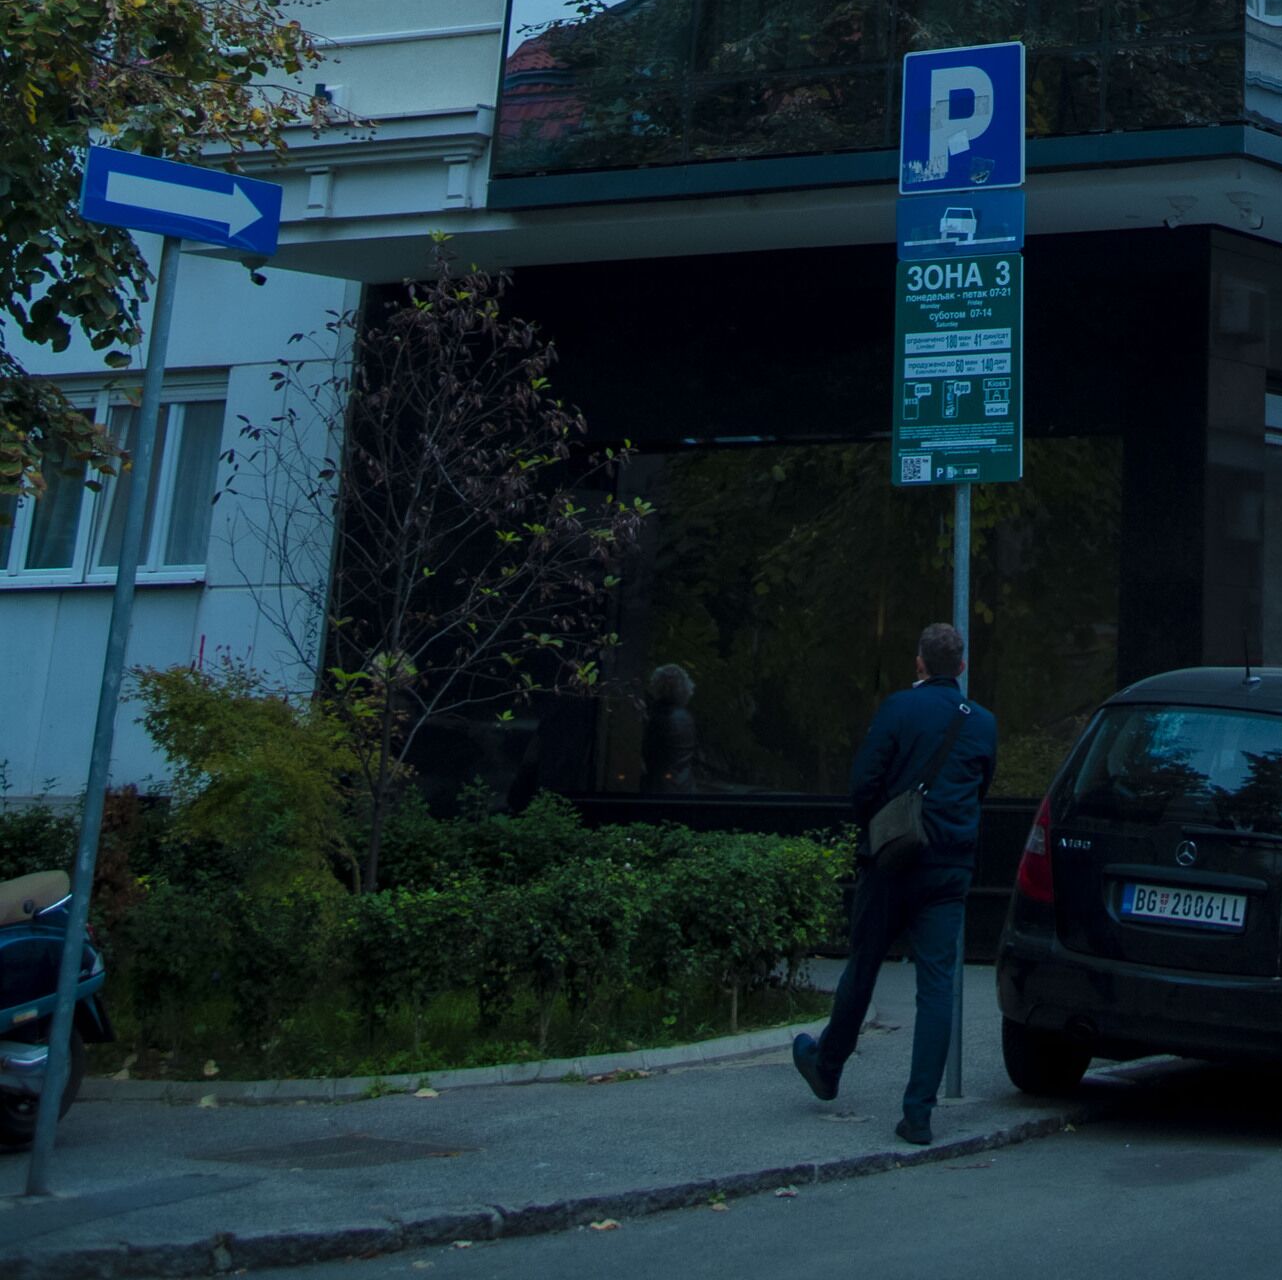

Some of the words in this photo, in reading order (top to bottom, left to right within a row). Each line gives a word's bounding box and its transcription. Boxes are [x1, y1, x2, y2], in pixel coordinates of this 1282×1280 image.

[929, 65, 994, 179] P
[906, 262, 984, 291] ЗОНА
[994, 260, 1011, 286] 3
[905, 292, 956, 303] понедељак
[962, 290, 988, 300] петак
[989, 287, 1011, 298] 07-21
[929, 310, 966, 322] суботом
[969, 308, 993, 319] 07-14
[1135, 888, 1157, 913] BG
